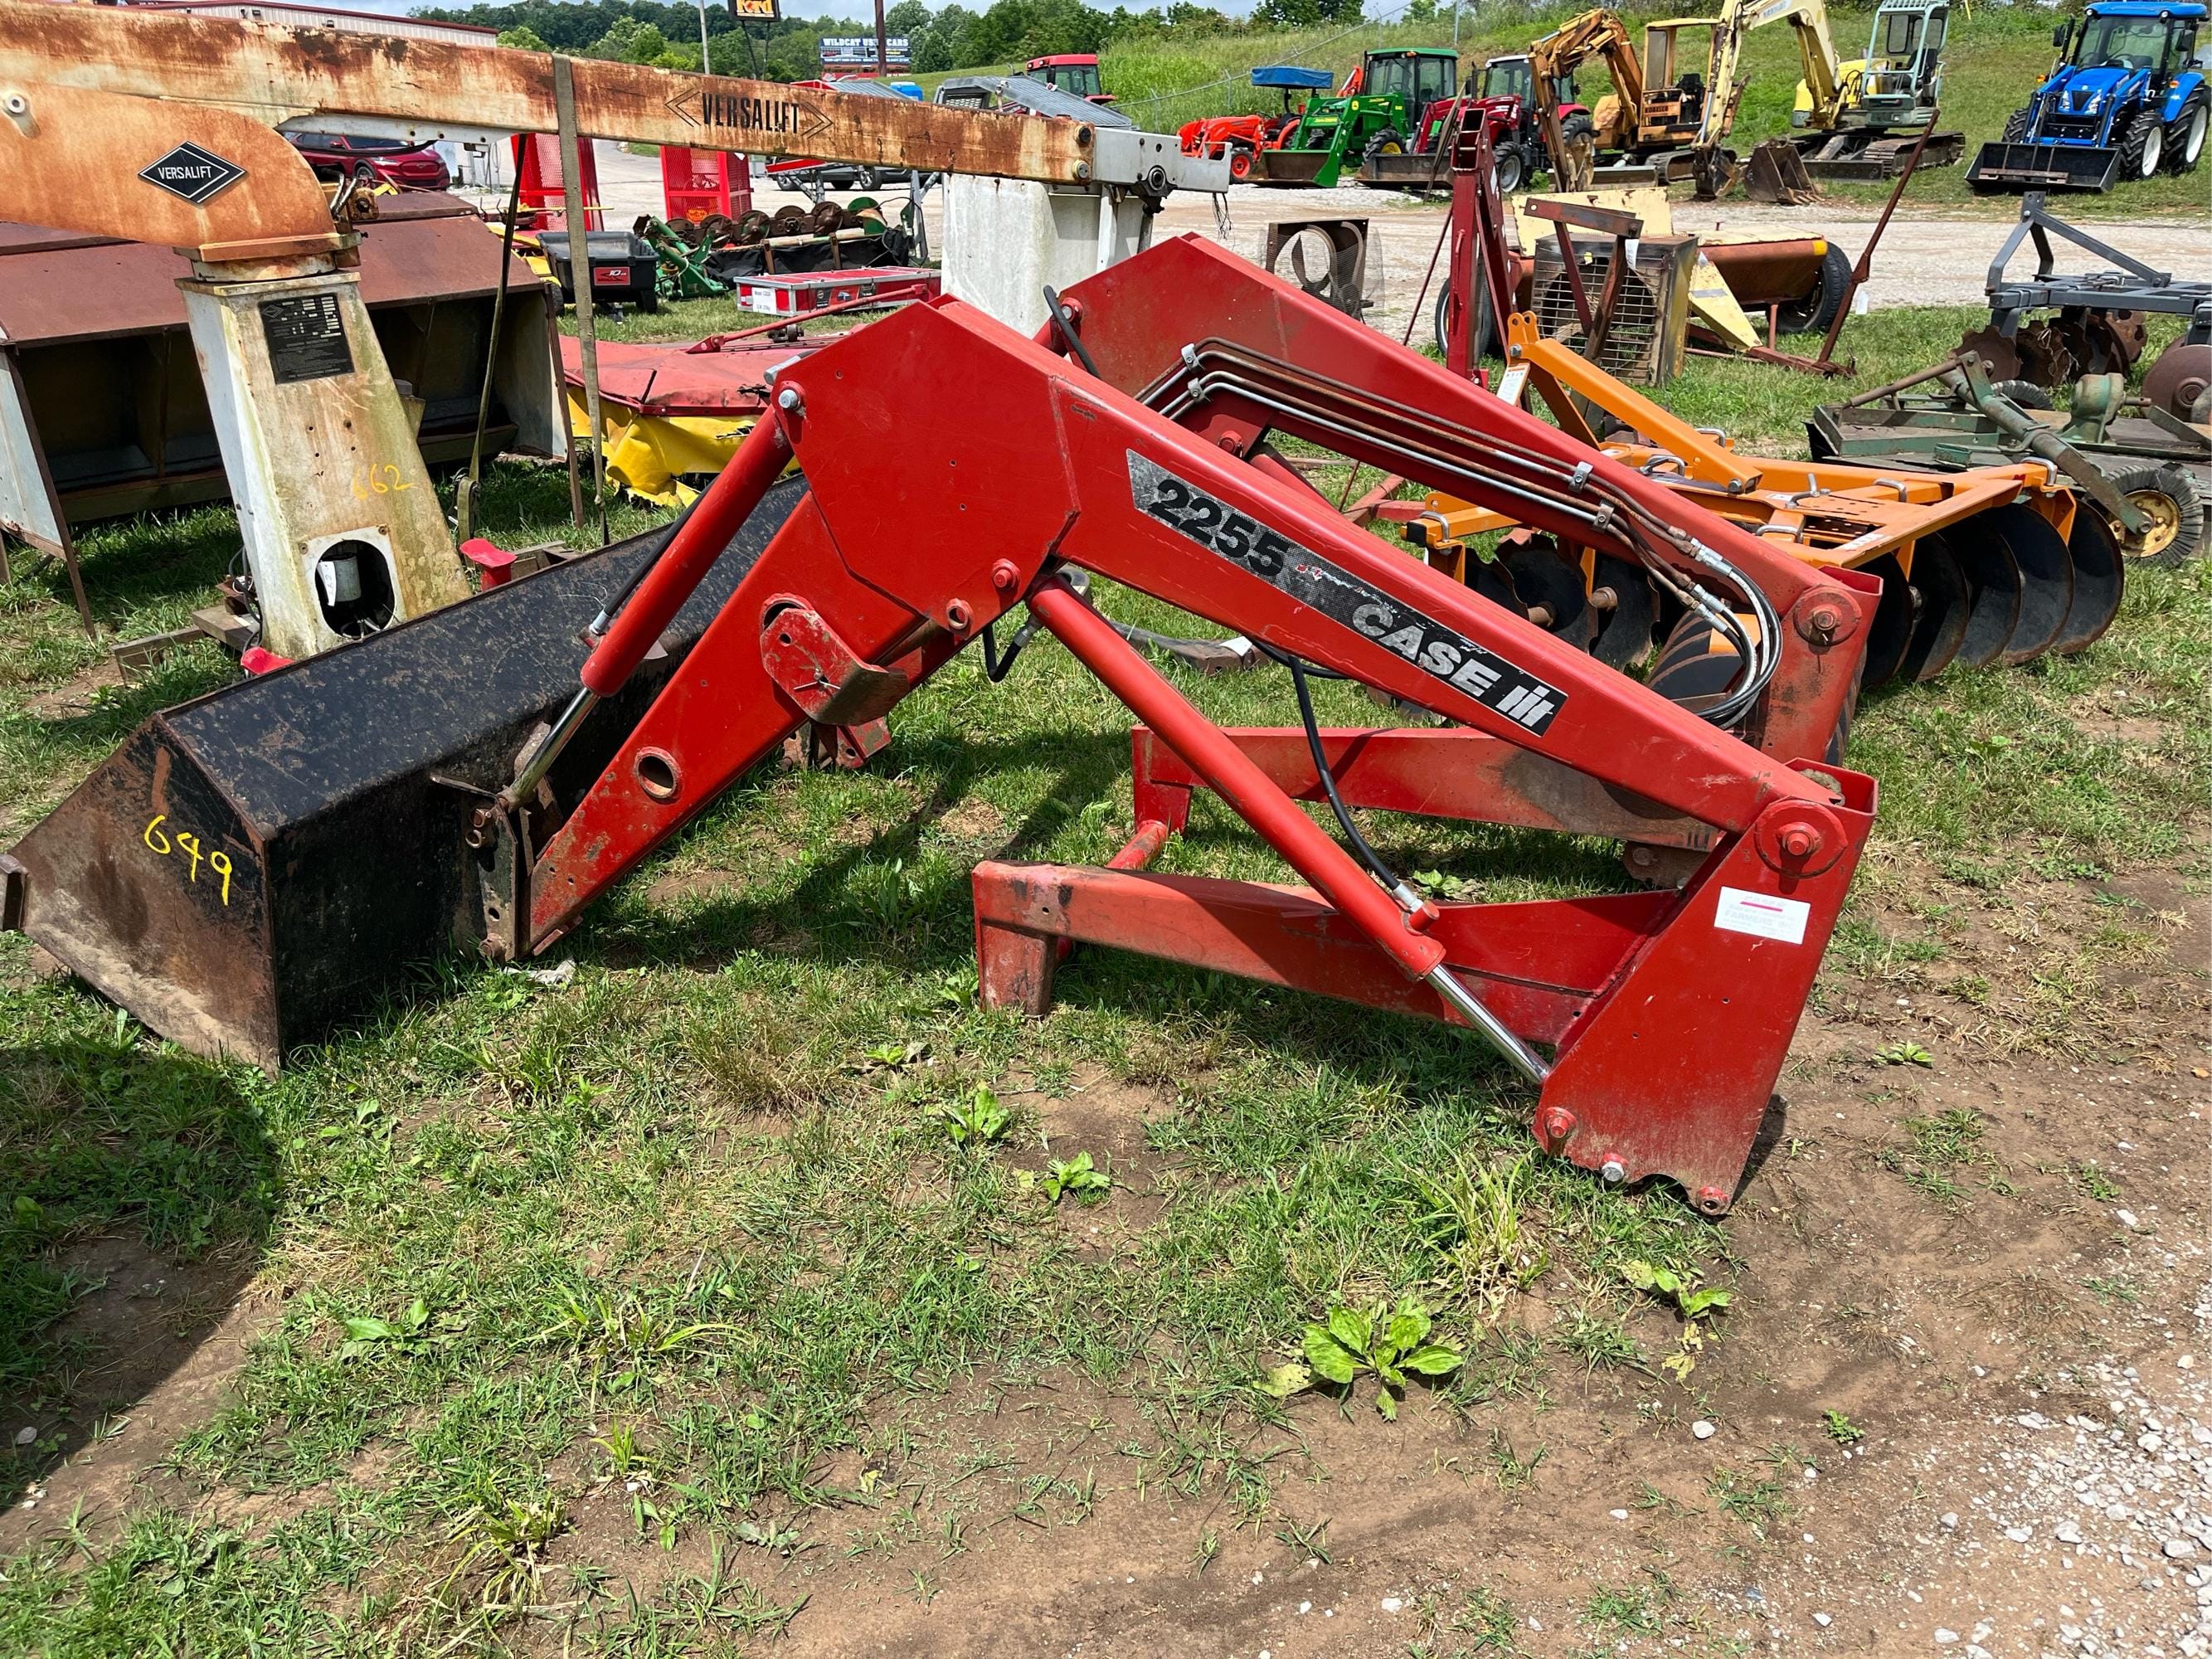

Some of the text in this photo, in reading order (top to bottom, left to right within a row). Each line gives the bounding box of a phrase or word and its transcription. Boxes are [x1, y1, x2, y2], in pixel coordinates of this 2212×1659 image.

[887, 38, 908, 46] CARS
[702, 93, 800, 134] VERSALIFT
[158, 166, 211, 179] VERSALIFT
[1148, 479, 1289, 577] 2255
[1352, 603, 1502, 697] CASE
[144, 815, 232, 906] 649
